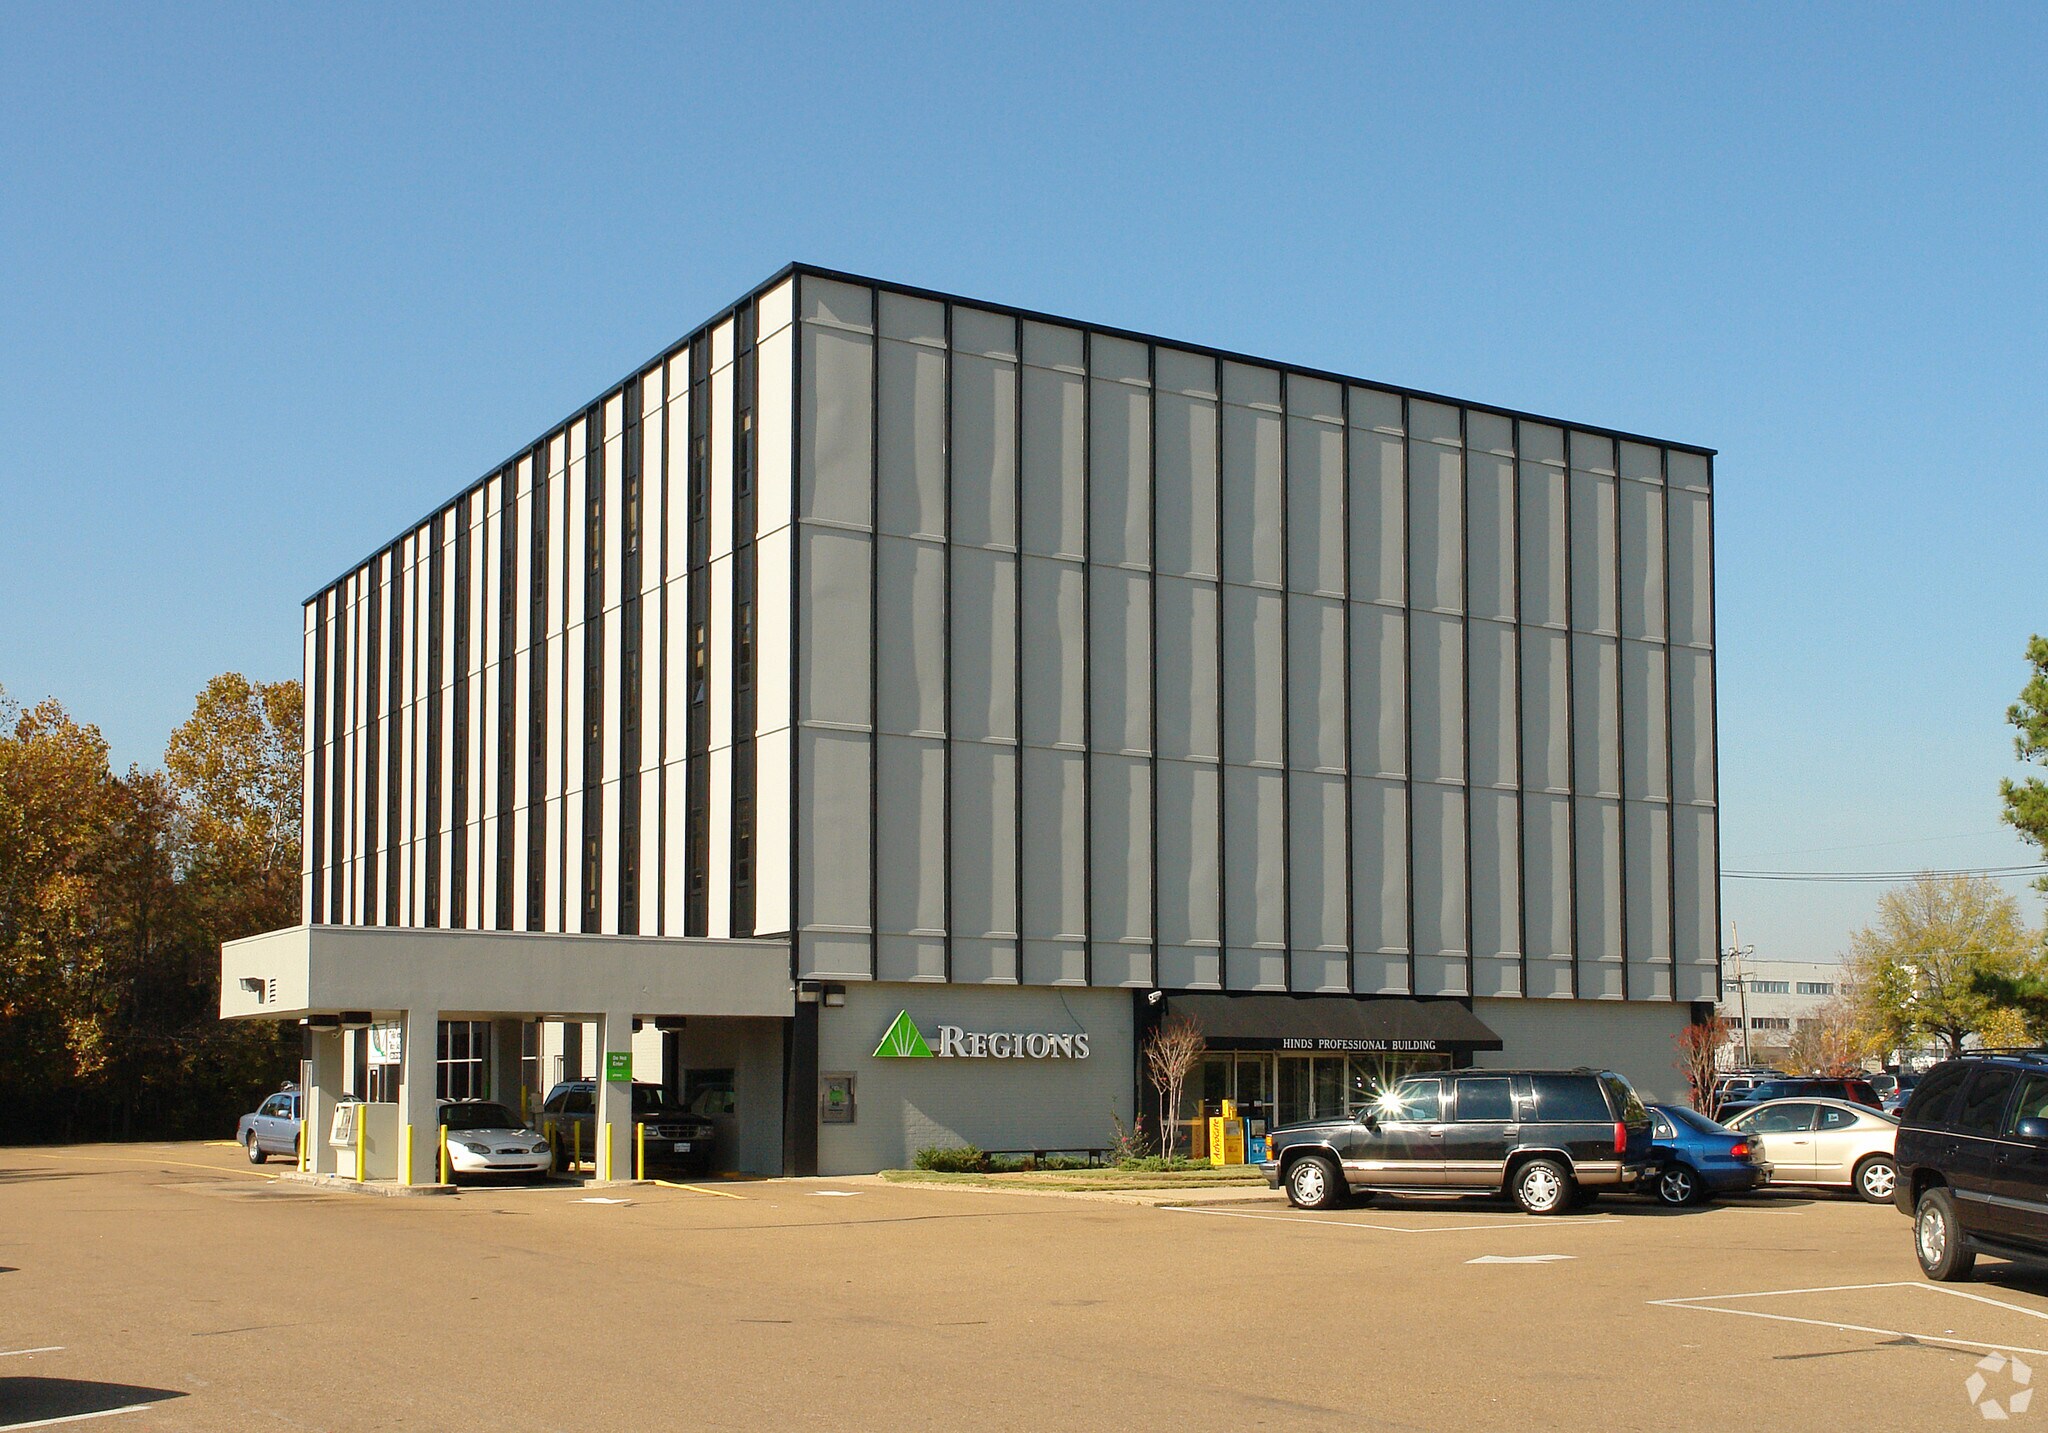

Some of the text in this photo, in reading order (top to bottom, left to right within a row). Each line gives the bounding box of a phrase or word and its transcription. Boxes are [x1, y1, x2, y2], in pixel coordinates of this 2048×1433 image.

[938, 1025, 1090, 1059] REGIONS
[1282, 1038, 1436, 1050] HINDS PROFESSIONAL BUILDING
